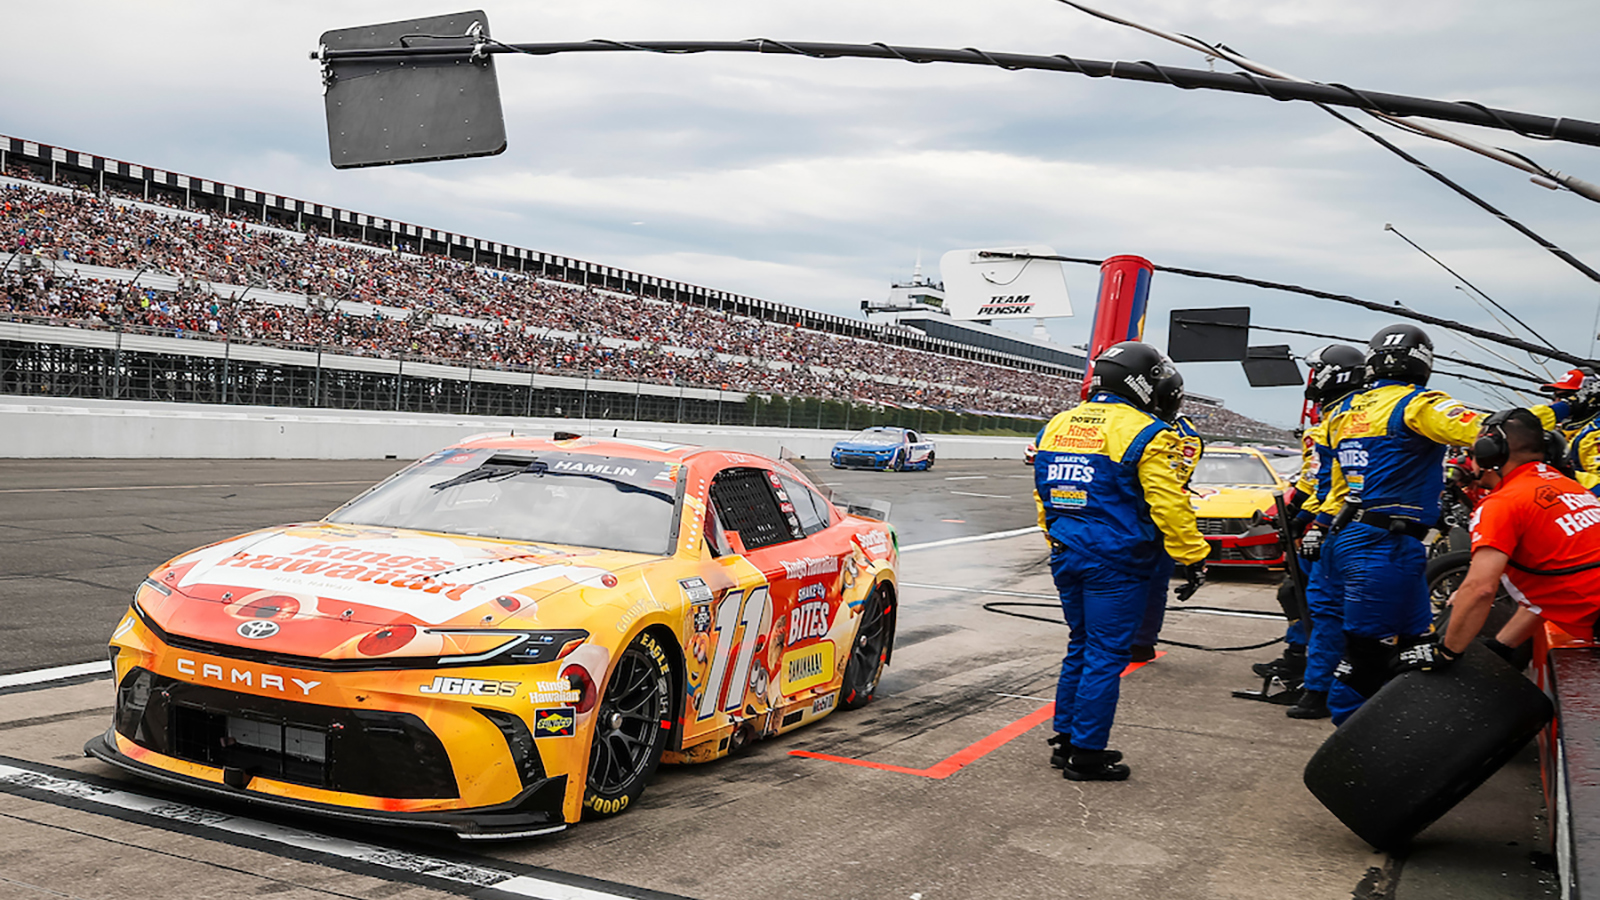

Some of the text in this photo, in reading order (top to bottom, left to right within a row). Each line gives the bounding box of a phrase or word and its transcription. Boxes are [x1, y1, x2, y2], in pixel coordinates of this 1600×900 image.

[990, 295, 1030, 304] TEAM
[978, 306, 1032, 315] PENSKE
[1383, 334, 1405, 346] 11
[1103, 347, 1125, 358] 11
[1336, 371, 1351, 383] 11
[1070, 416, 1106, 424] DOWELL
[1067, 424, 1098, 439] King's
[1053, 435, 1104, 449] Hawaiian
[555, 460, 637, 477] HAMLIN
[1047, 463, 1095, 483] BITES
[291, 544, 455, 573] King's
[216, 551, 474, 602] Hawaiian
[788, 601, 830, 647] BITES
[640, 633, 670, 675] EAGLE
[697, 585, 769, 722] 11
[177, 658, 321, 695] CAMRY
[536, 679, 571, 694] King's
[529, 690, 581, 704] Hawaiian
[537, 717, 573, 730] SUNOCO
